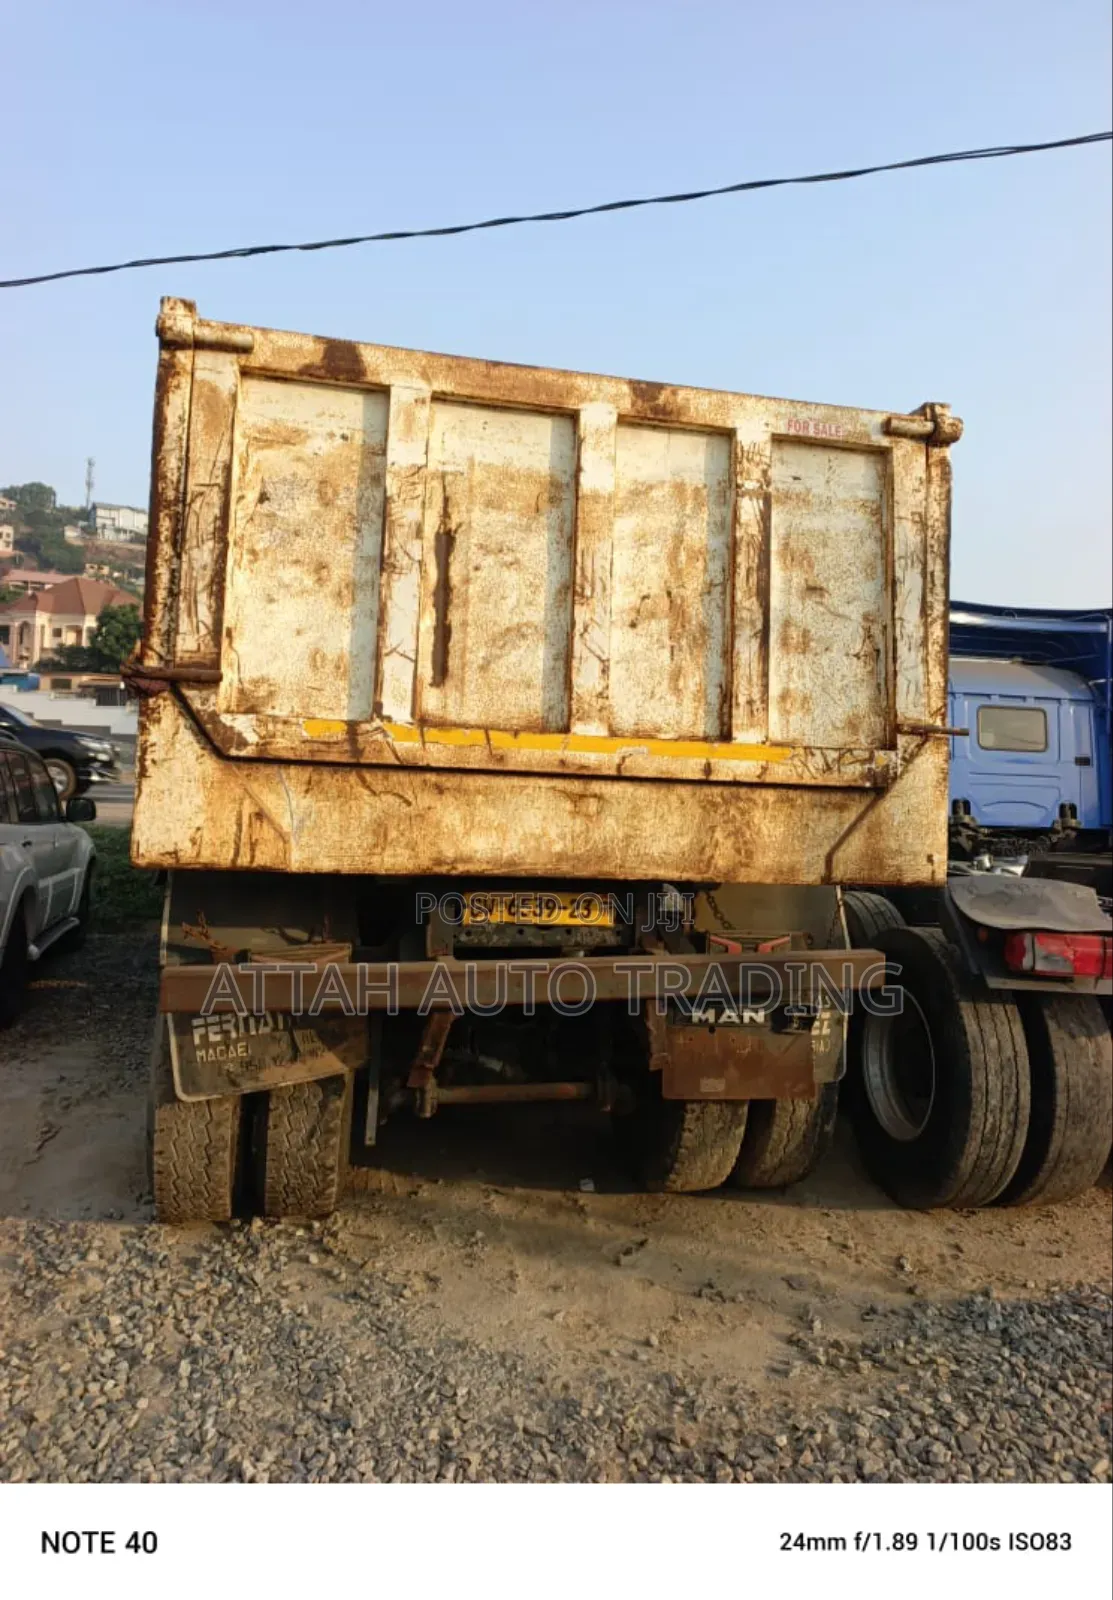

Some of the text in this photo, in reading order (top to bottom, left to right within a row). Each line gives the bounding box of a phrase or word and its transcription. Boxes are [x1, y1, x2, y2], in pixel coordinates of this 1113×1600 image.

[787, 417, 844, 437] FOR SALE
[691, 1007, 765, 1024] MAN
